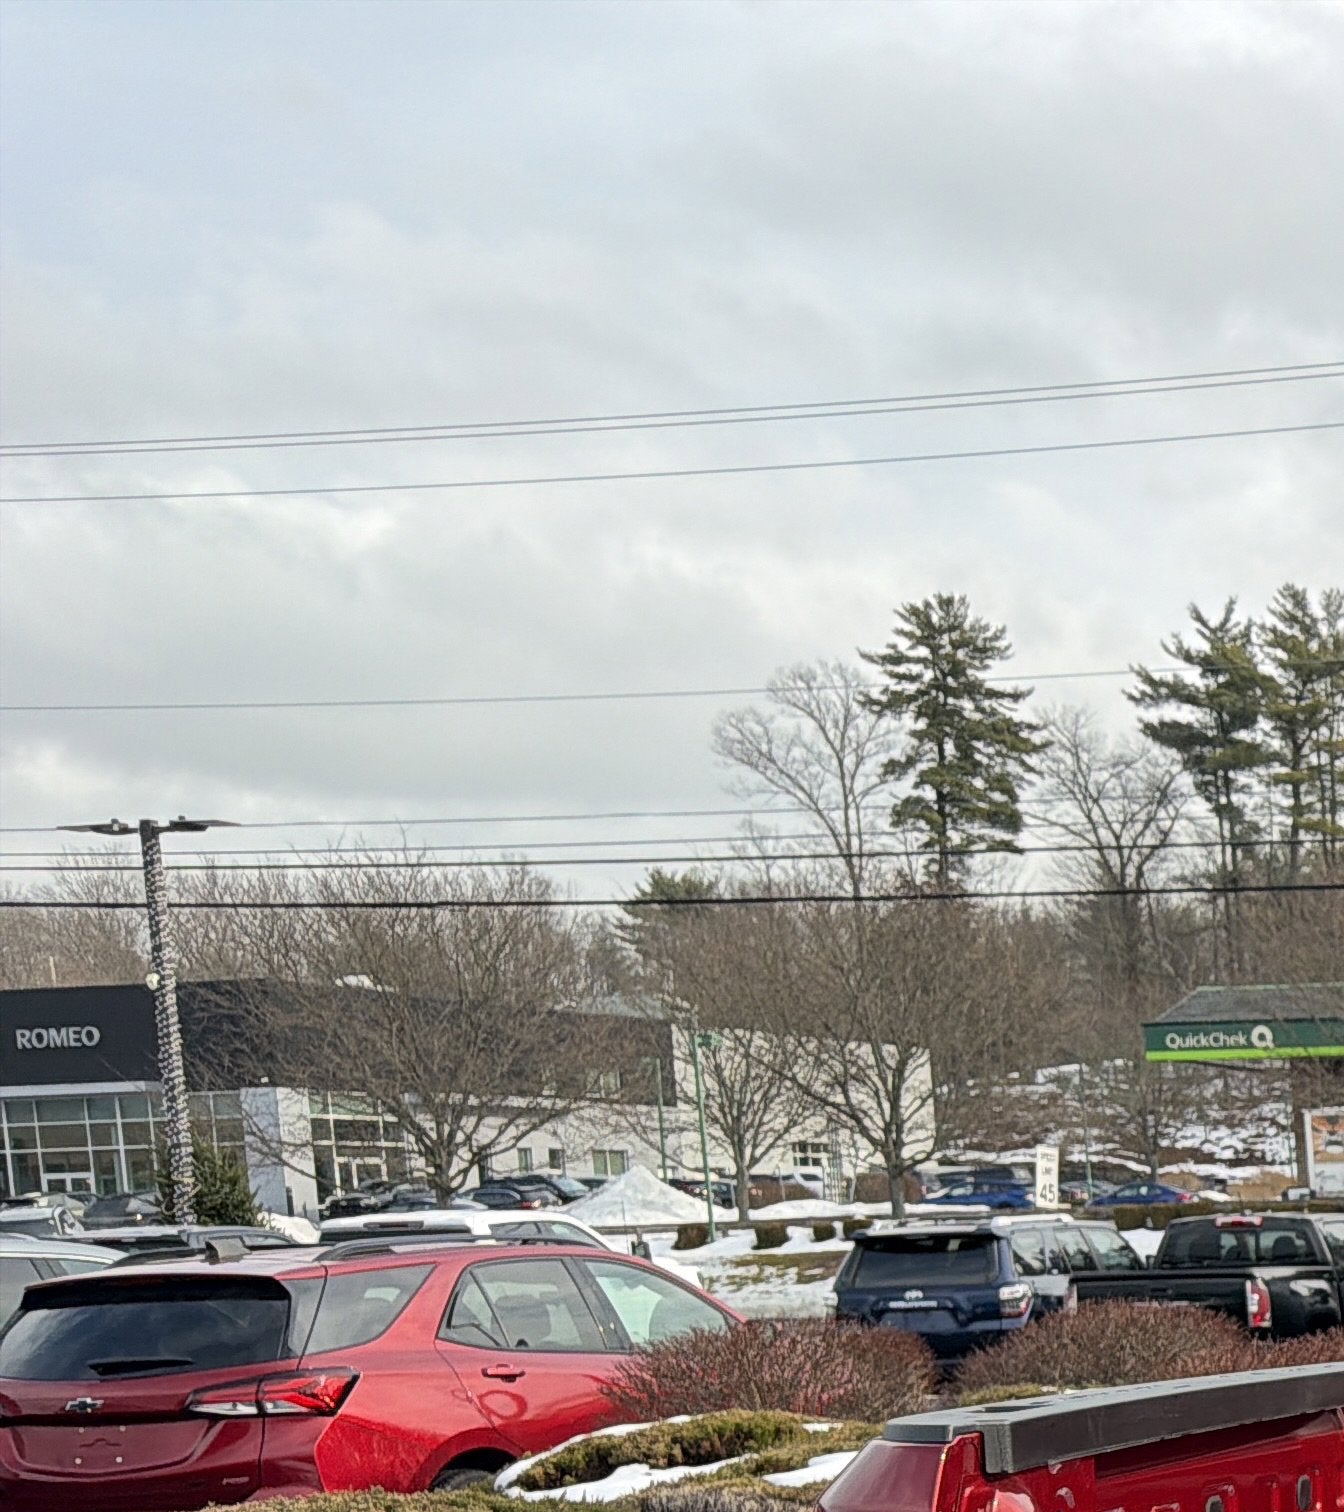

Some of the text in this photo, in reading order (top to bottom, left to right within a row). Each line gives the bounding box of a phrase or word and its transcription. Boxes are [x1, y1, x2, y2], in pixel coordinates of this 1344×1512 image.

[15, 1025, 100, 1050] ROMEO
[1165, 1031, 1248, 1050] QuickChek
[1040, 1183, 1056, 1203] 45
